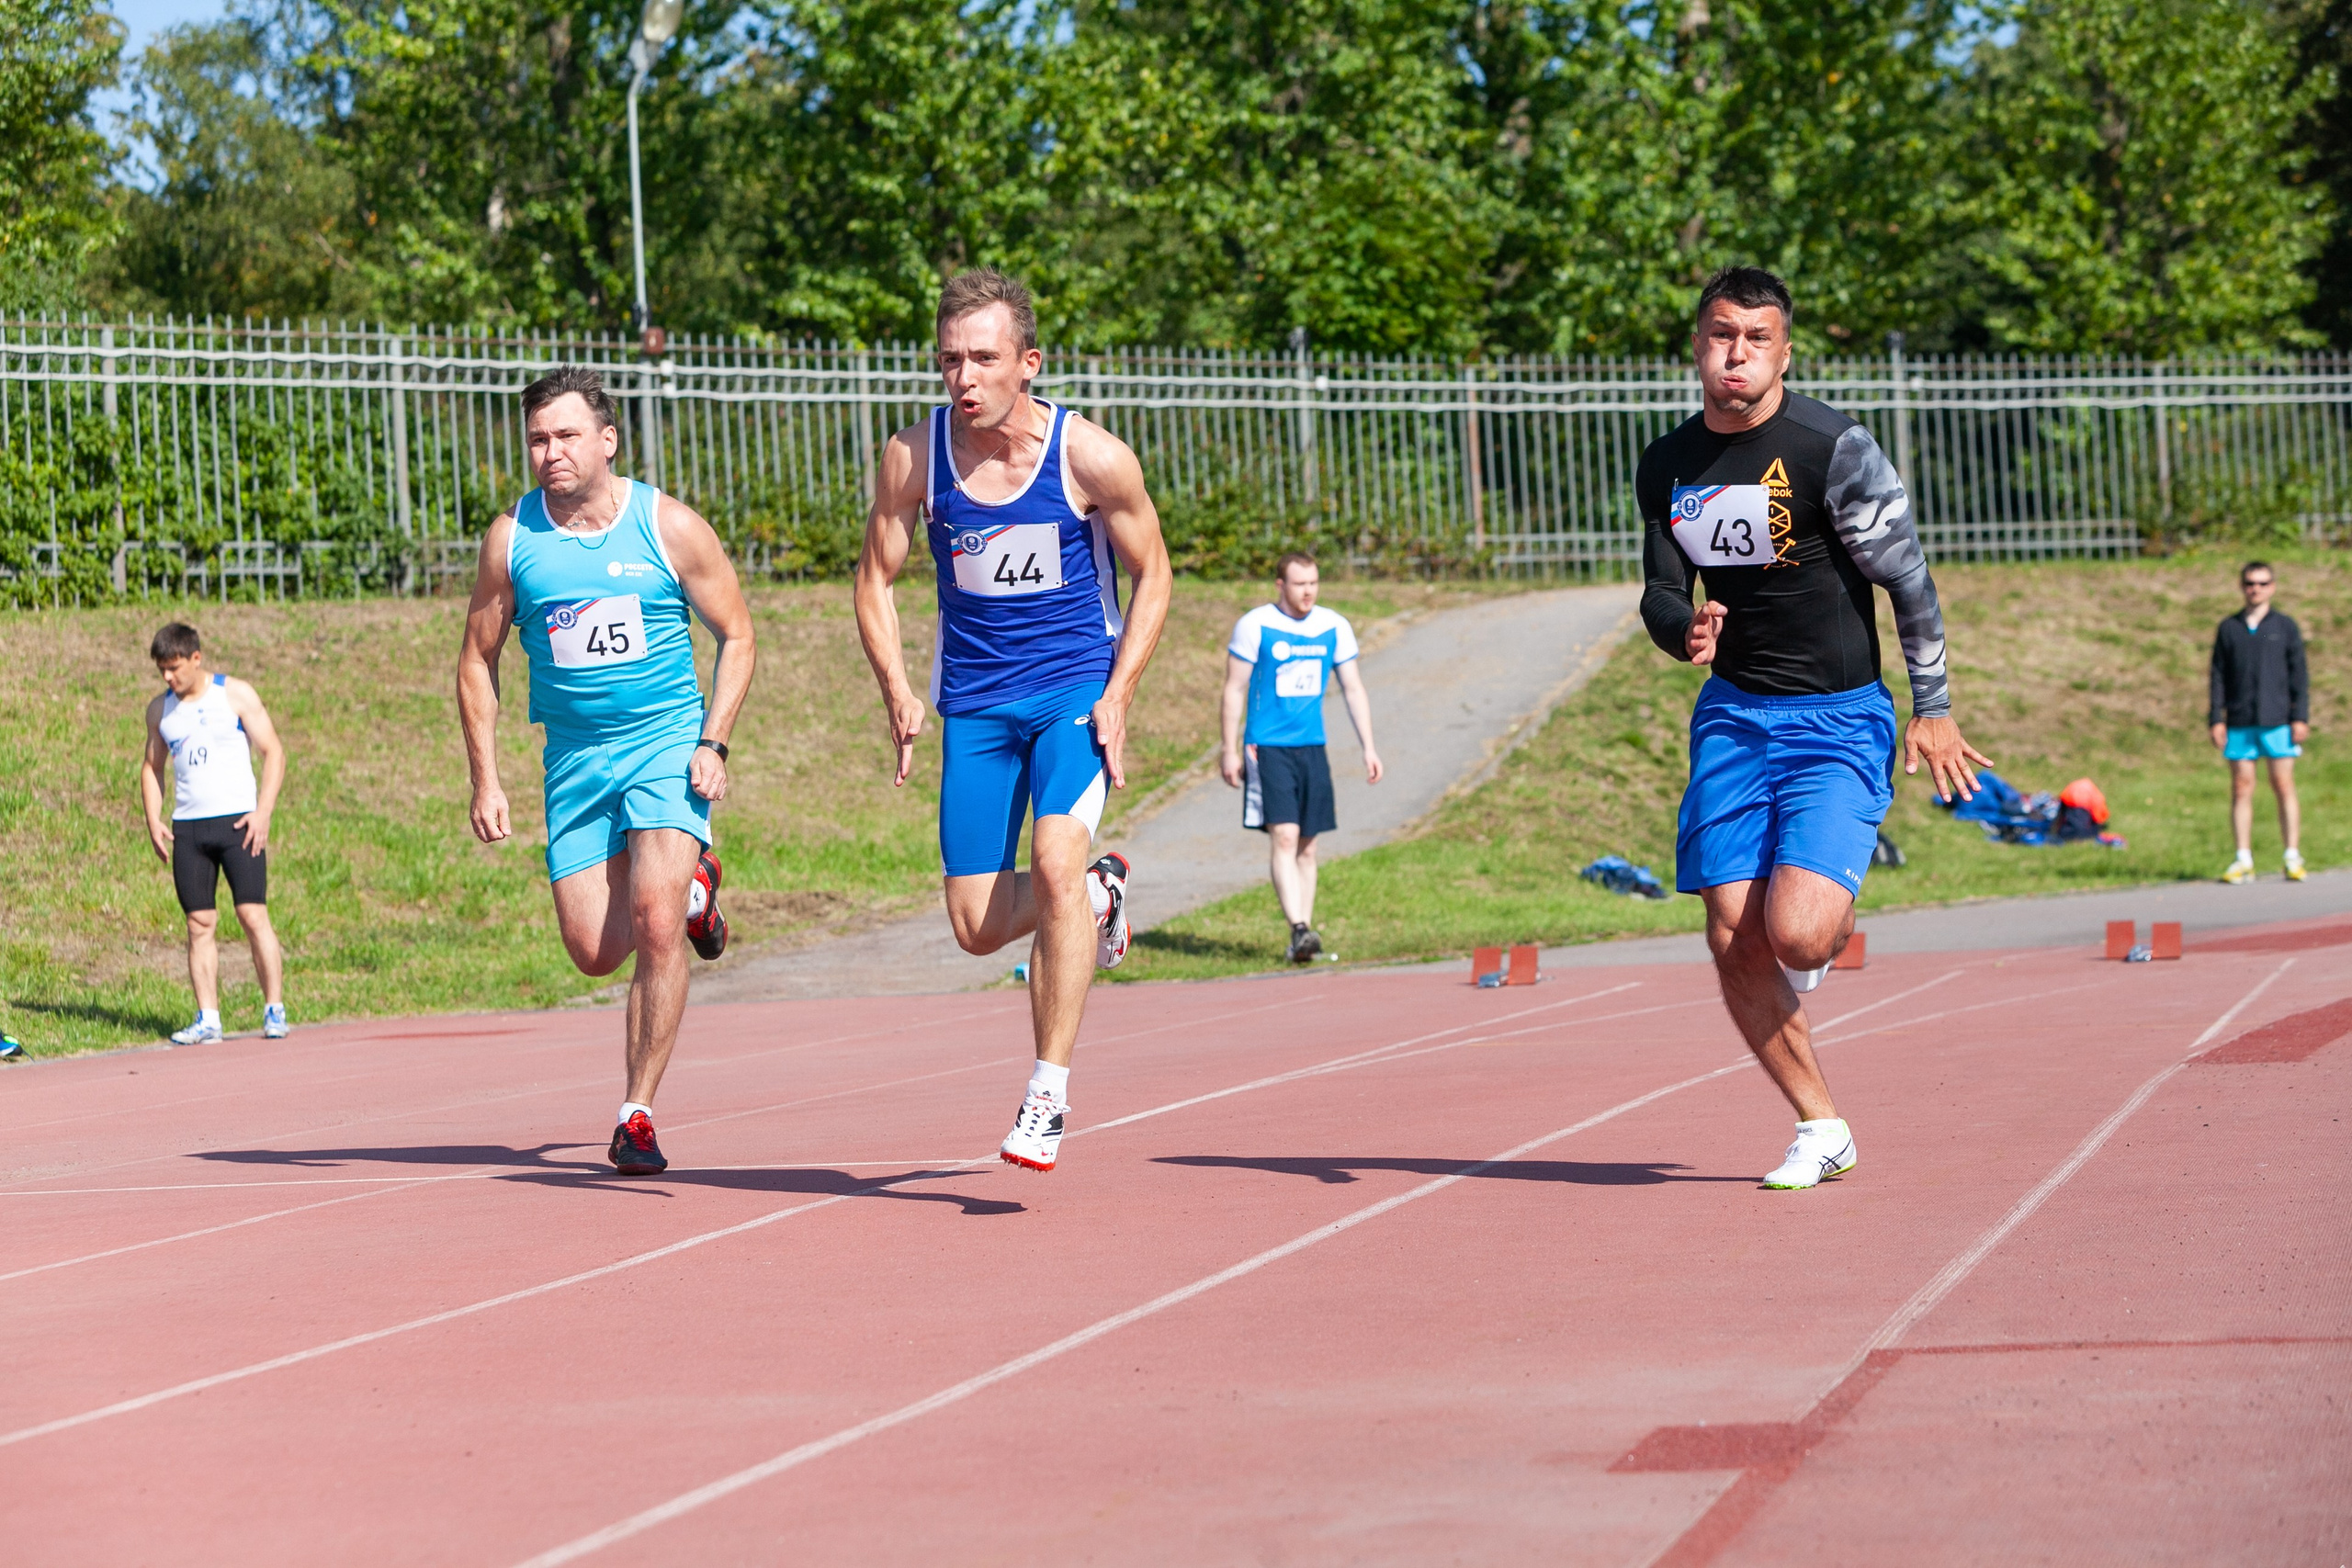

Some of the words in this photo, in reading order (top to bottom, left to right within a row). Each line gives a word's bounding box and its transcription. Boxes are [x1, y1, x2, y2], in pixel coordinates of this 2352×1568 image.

[1769, 488, 1792, 498] ebok
[1710, 518, 1755, 558] 43
[993, 553, 1044, 586] 44
[586, 622, 629, 656] 45
[1295, 675, 1314, 690] 47
[188, 747, 208, 766] 49
[1846, 868, 1861, 885] KIPS
